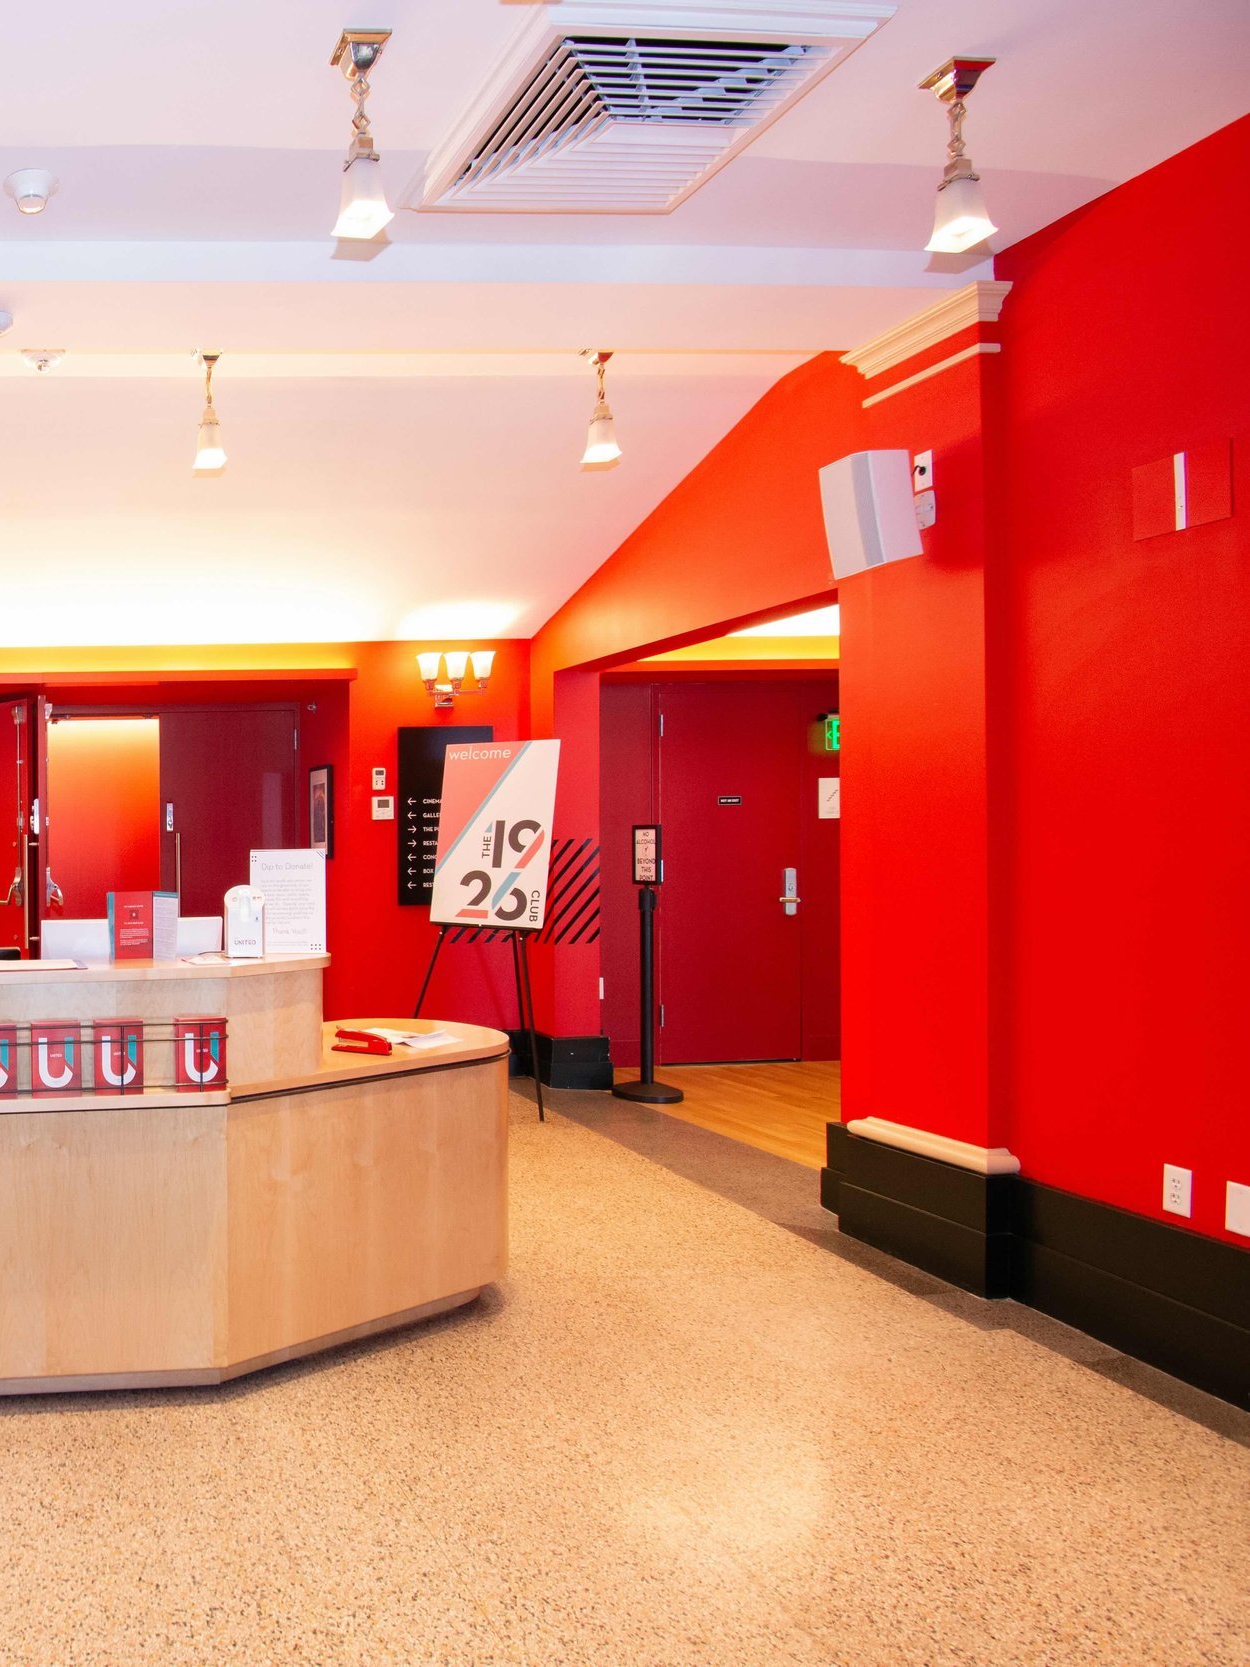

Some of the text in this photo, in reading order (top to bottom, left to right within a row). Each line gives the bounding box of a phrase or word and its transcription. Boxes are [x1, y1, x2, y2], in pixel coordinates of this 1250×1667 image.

[450, 746, 510, 760] welcome
[482, 835, 492, 859] THE
[529, 890, 540, 922] CLUB
